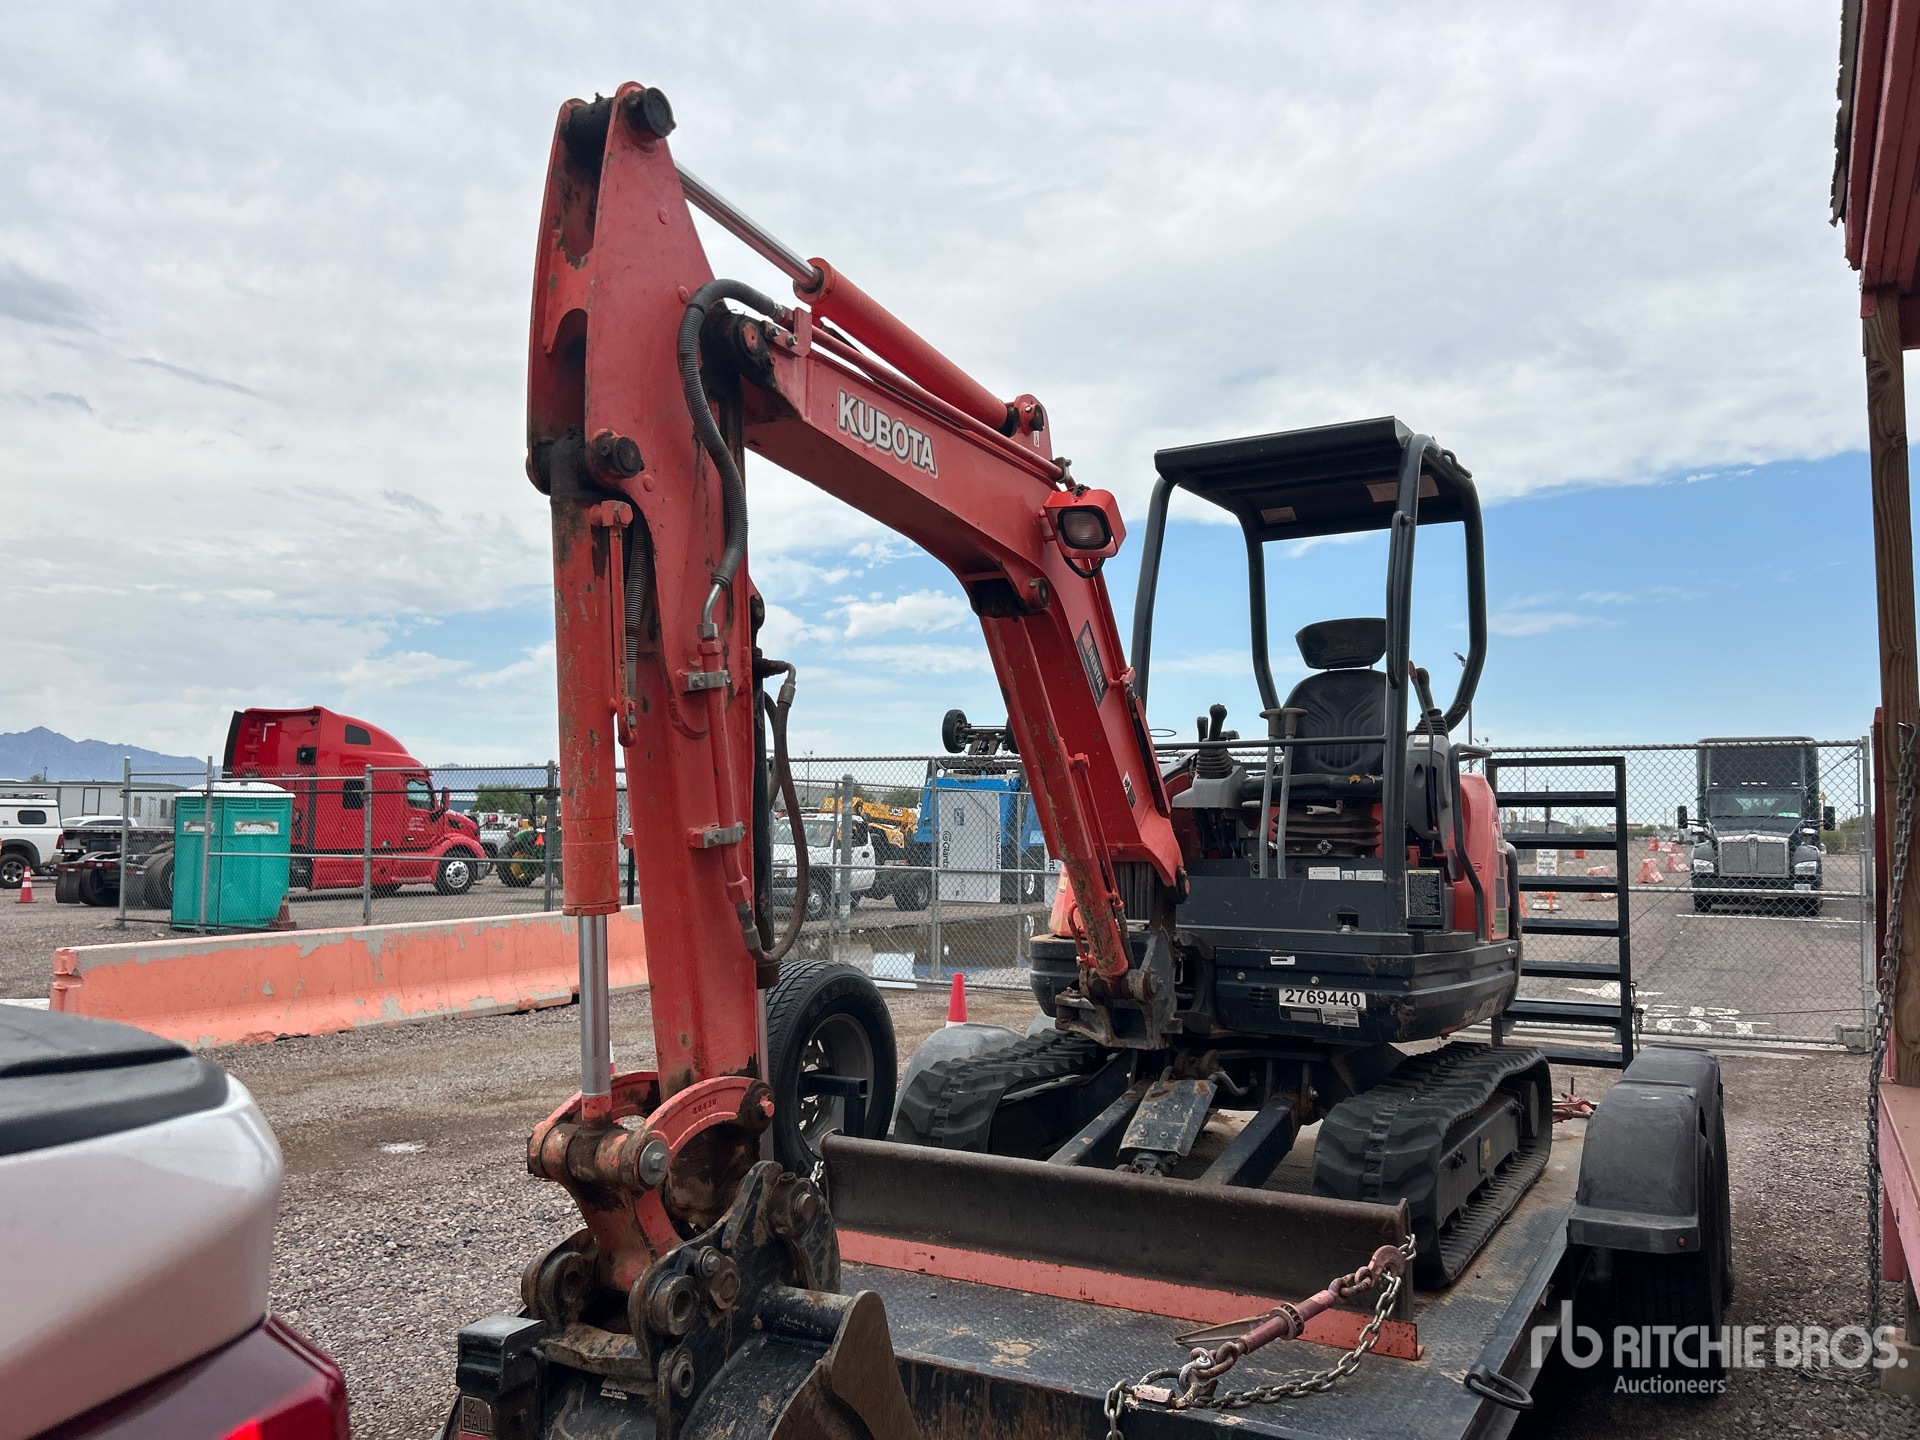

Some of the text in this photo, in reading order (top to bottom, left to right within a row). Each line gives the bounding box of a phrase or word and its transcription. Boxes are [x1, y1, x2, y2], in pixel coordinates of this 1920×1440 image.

[838, 389, 938, 476] KUBOTA
[1088, 647, 1104, 694] RENTAL
[1284, 988, 1361, 1008] 2769440
[469, 1400, 476, 1414] 2
[464, 1414, 492, 1432] BALL
